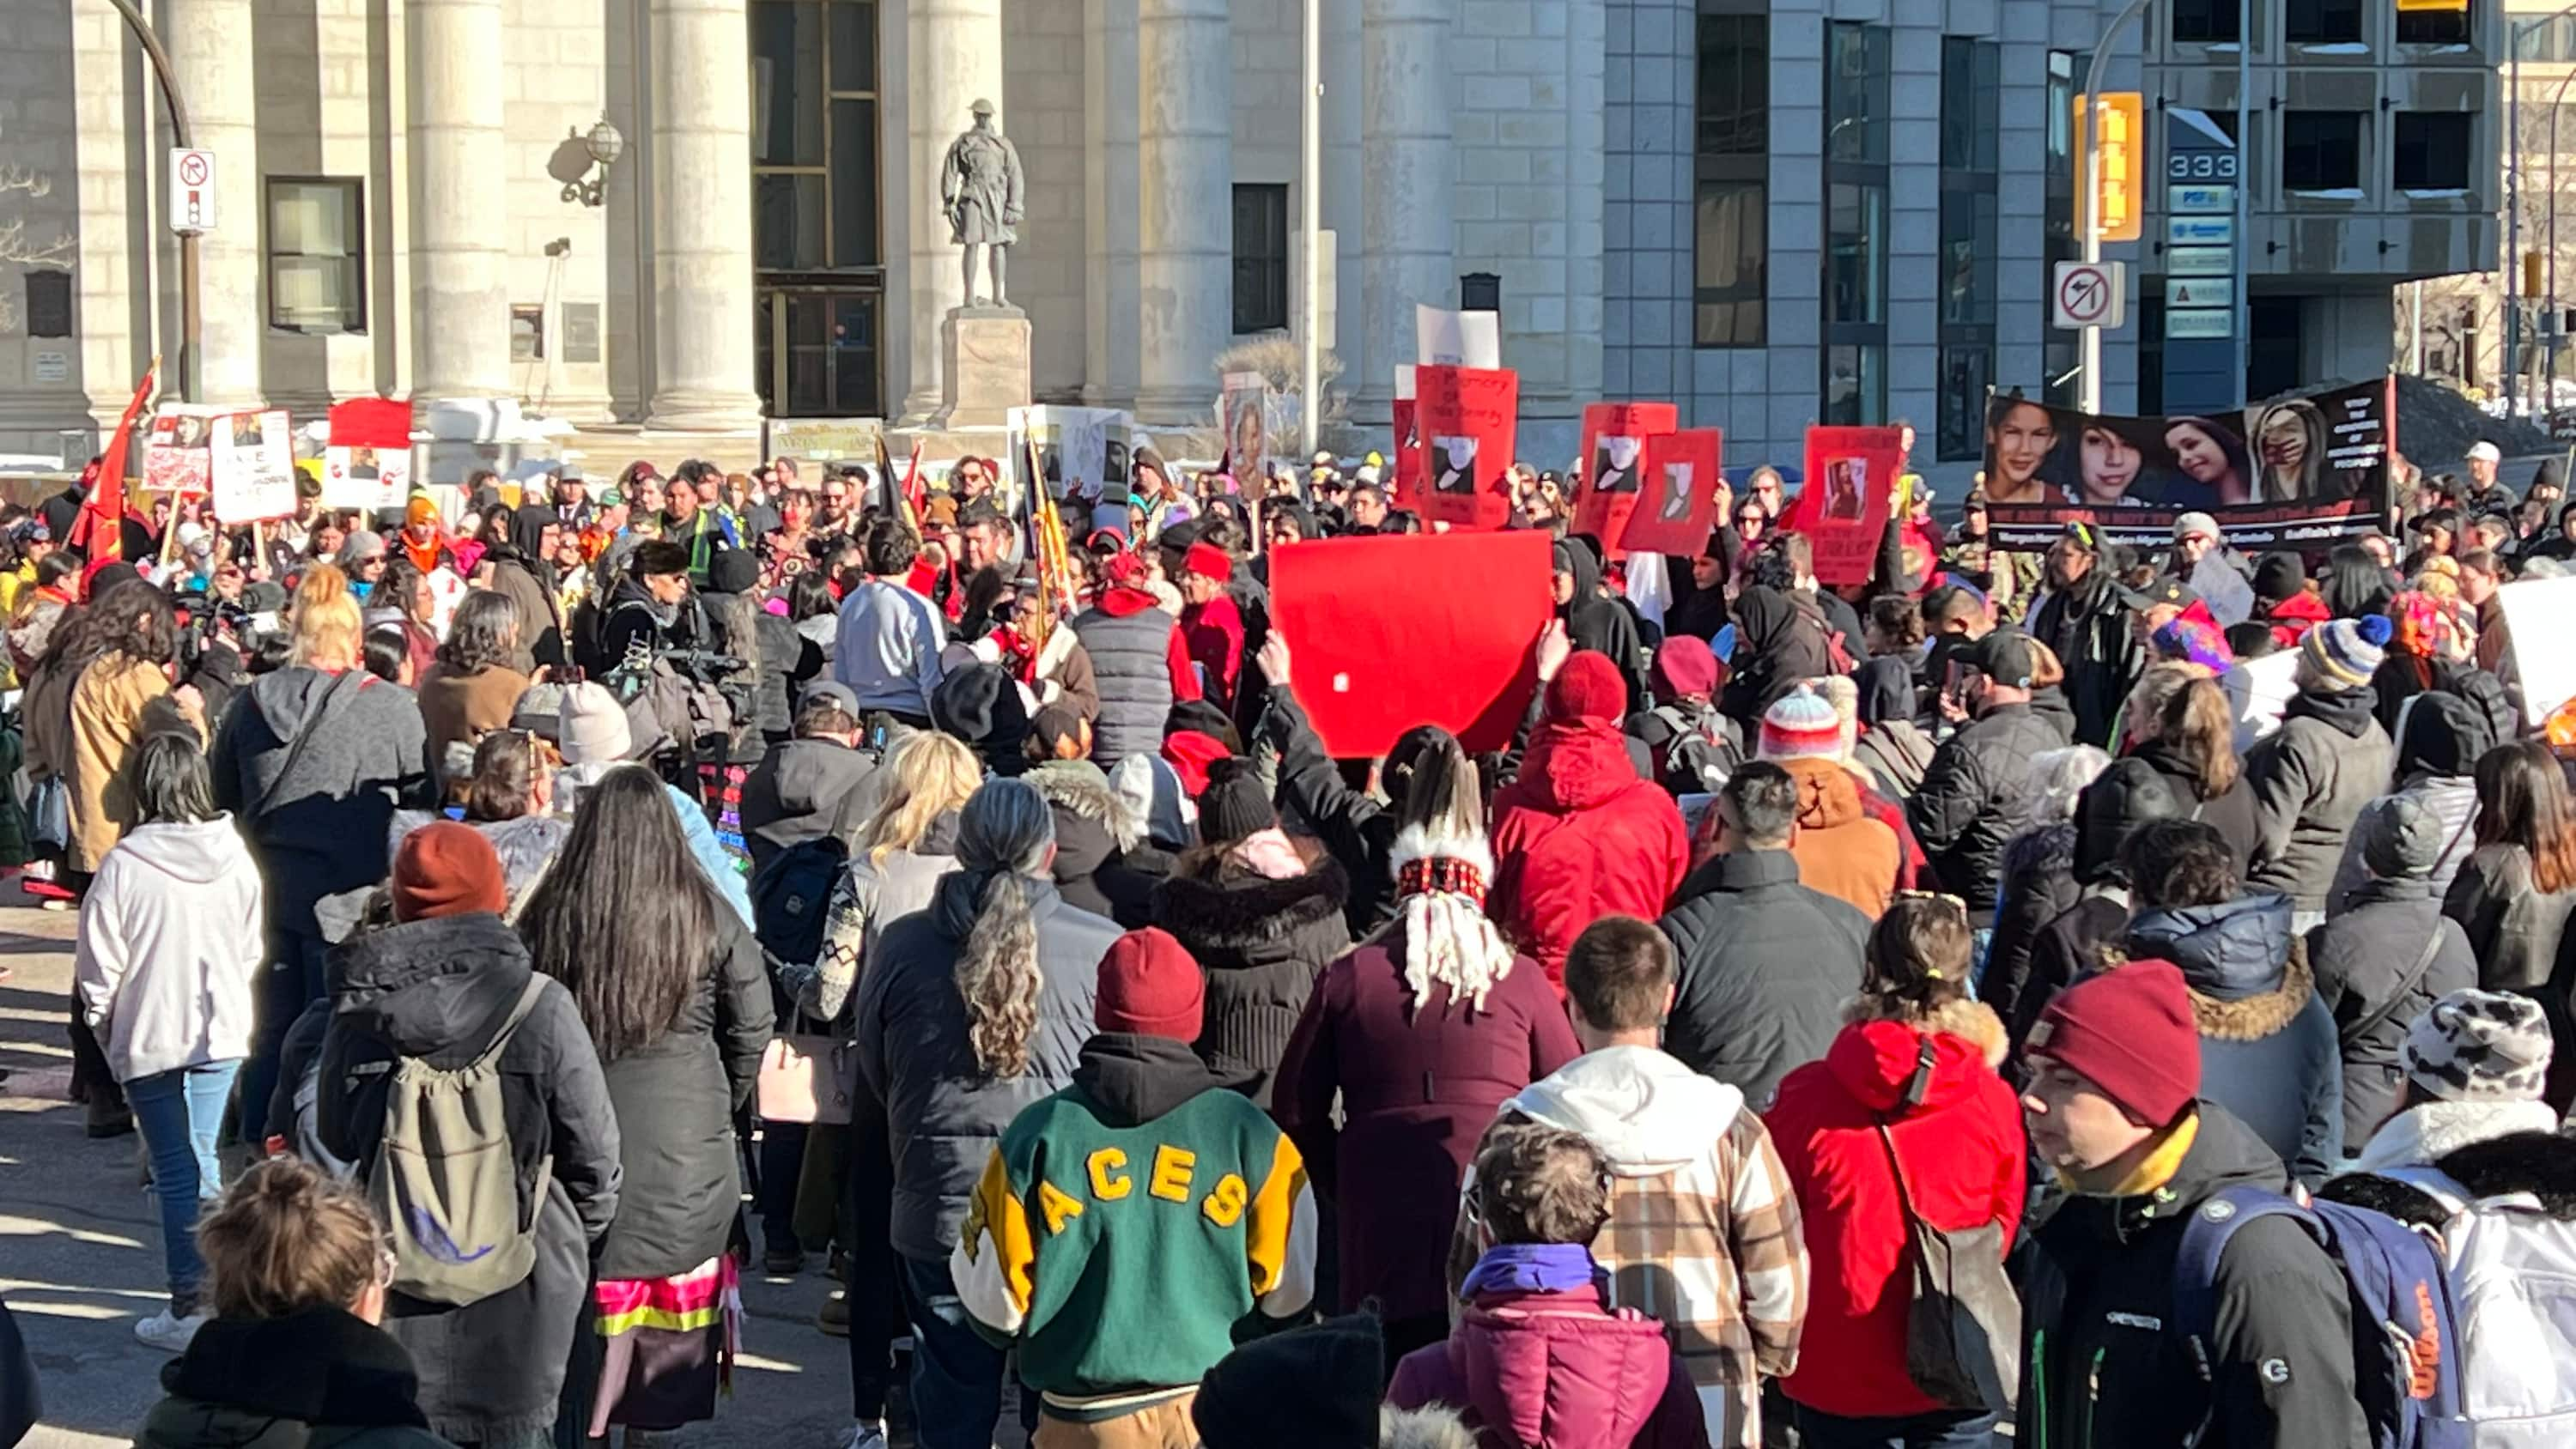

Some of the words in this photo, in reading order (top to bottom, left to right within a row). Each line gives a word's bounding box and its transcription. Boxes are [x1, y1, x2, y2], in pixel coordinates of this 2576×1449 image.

[2169, 155, 2237, 177] 333
[1038, 1144, 1248, 1234] ACES
[2409, 1282, 2441, 1401] Wilson
